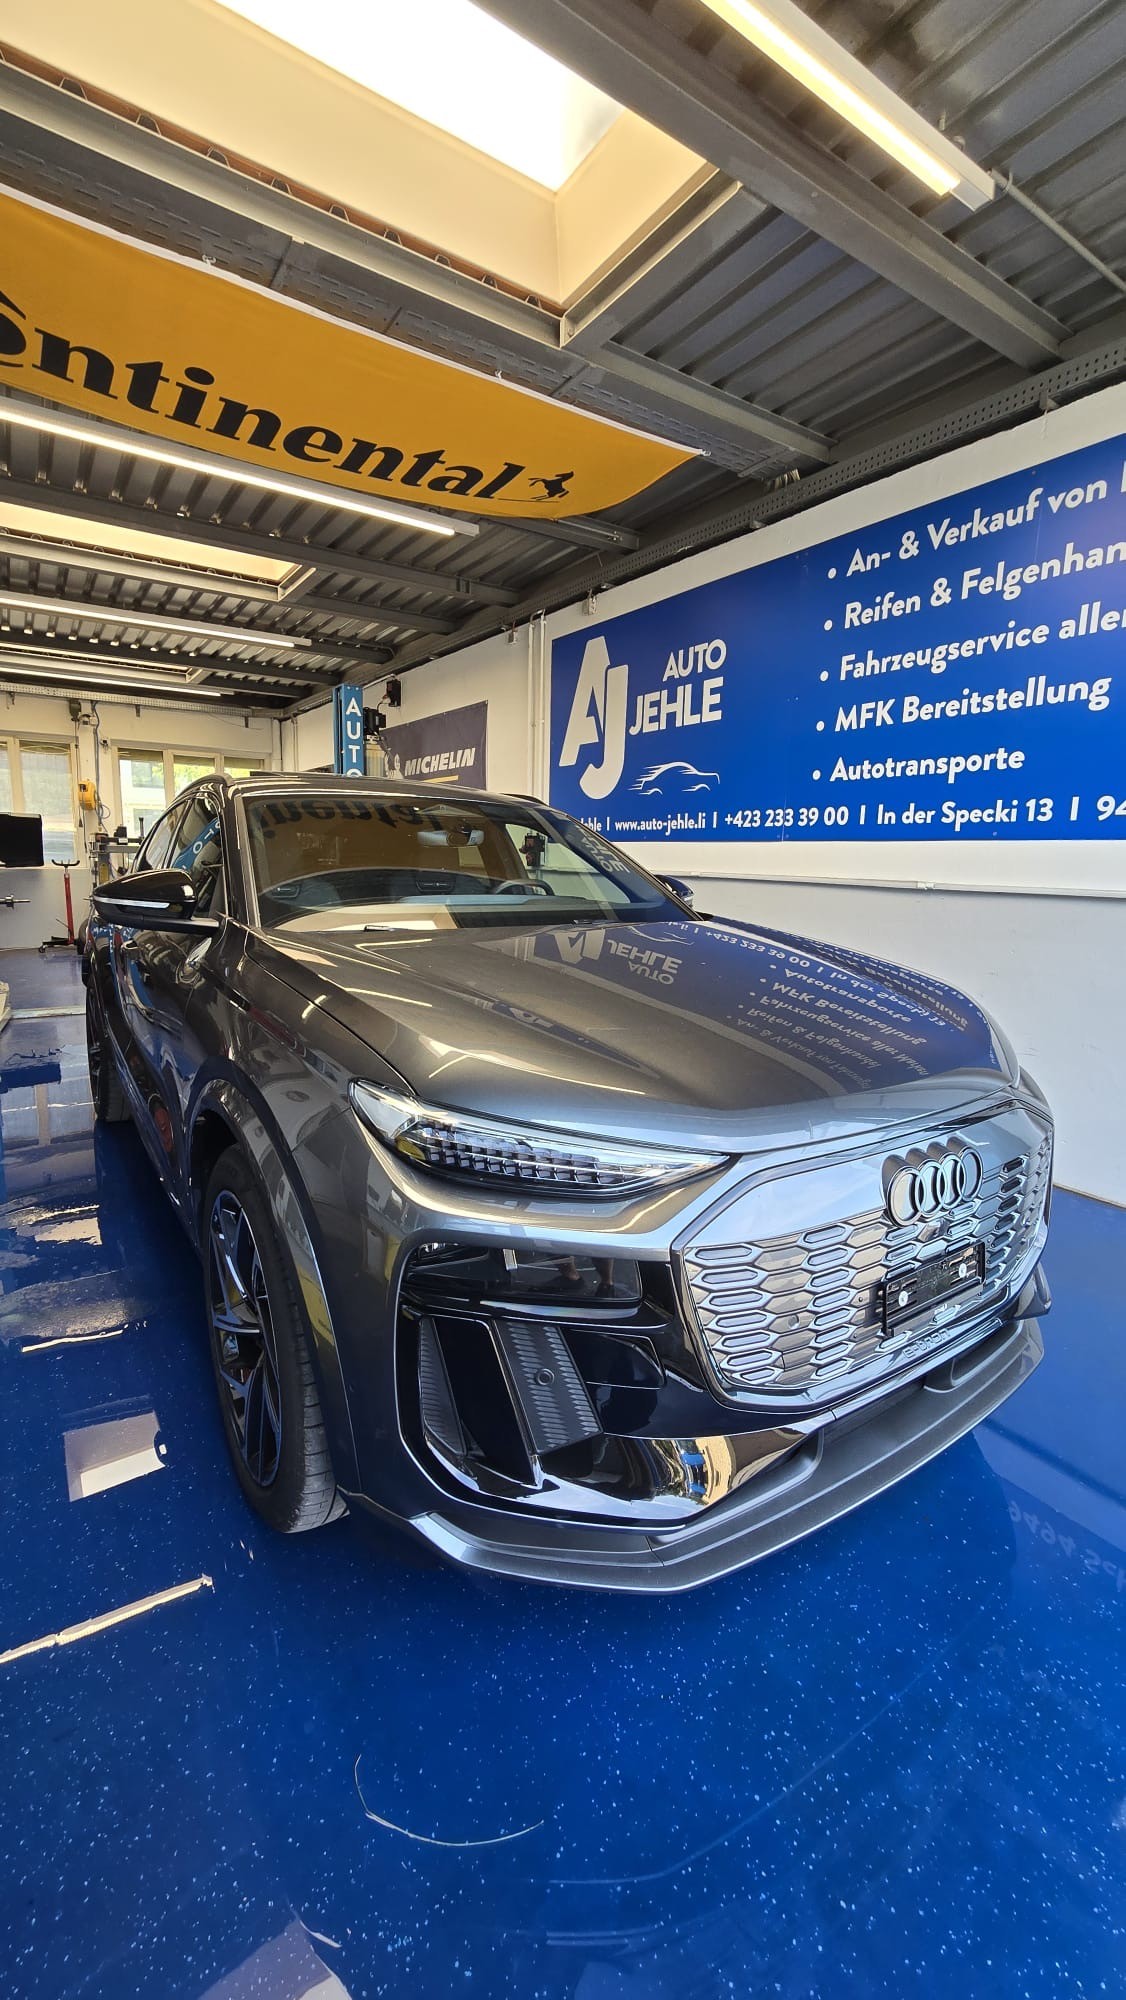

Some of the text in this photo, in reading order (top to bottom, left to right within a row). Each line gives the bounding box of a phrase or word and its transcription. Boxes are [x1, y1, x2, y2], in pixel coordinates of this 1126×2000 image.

[846, 479, 1107, 577] An- & Verkauf von
[844, 591, 921, 629] Reifen
[930, 577, 952, 607] &
[662, 639, 727, 682] AUTO
[840, 620, 1049, 681] Fahrzeugservice
[628, 676, 724, 735] JEHLE
[834, 675, 1112, 732] MFK Bereitstellung
[404, 747, 476, 777] MICHELIN
[829, 747, 1026, 784] Autotransporte
[615, 812, 706, 836] www.auto-jehle.li
[724, 809, 761, 828] +423
[765, 808, 794, 828] 233
[798, 807, 819, 827] 39
[823, 806, 849, 826] 00
[877, 803, 896, 825] In
[901, 803, 936, 824] der
[941, 799, 1018, 832] Specki
[1025, 797, 1054, 822] 13
